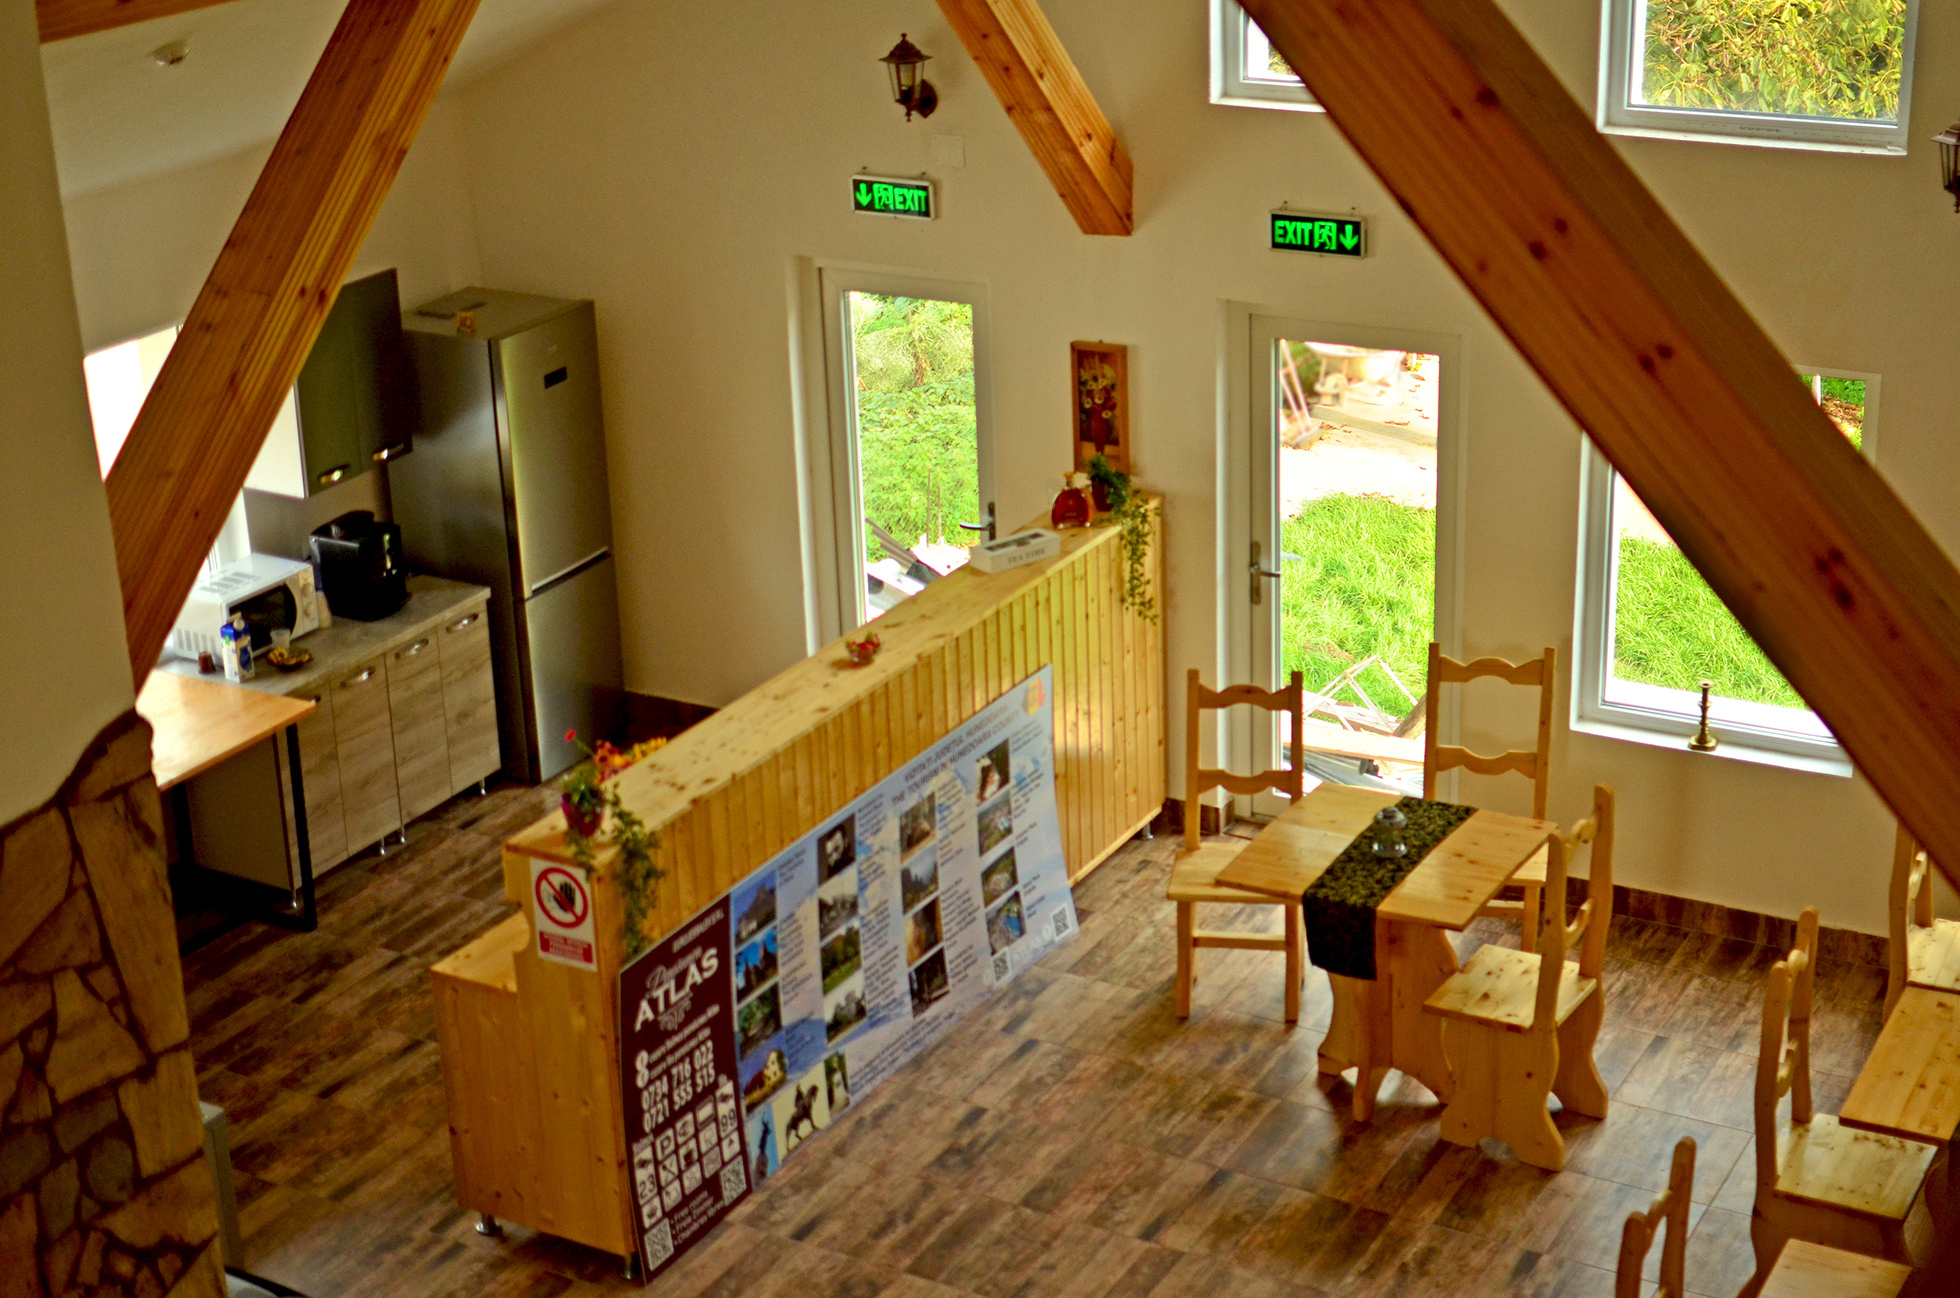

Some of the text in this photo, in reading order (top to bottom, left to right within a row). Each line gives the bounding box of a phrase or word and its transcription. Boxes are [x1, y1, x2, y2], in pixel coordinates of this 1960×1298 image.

[894, 187, 927, 213] EXIT
[1274, 220, 1312, 246] EXIT
[634, 947, 719, 1032] ATLAS
[641, 1074, 669, 1111] 0734
[671, 1056, 692, 1088] 716
[693, 1039, 714, 1070] 022
[643, 1096, 670, 1134] 0721
[673, 1079, 693, 1111] 555
[695, 1061, 715, 1093] 515
[720, 1108, 736, 1133] 99
[639, 1173, 656, 1200] 23
